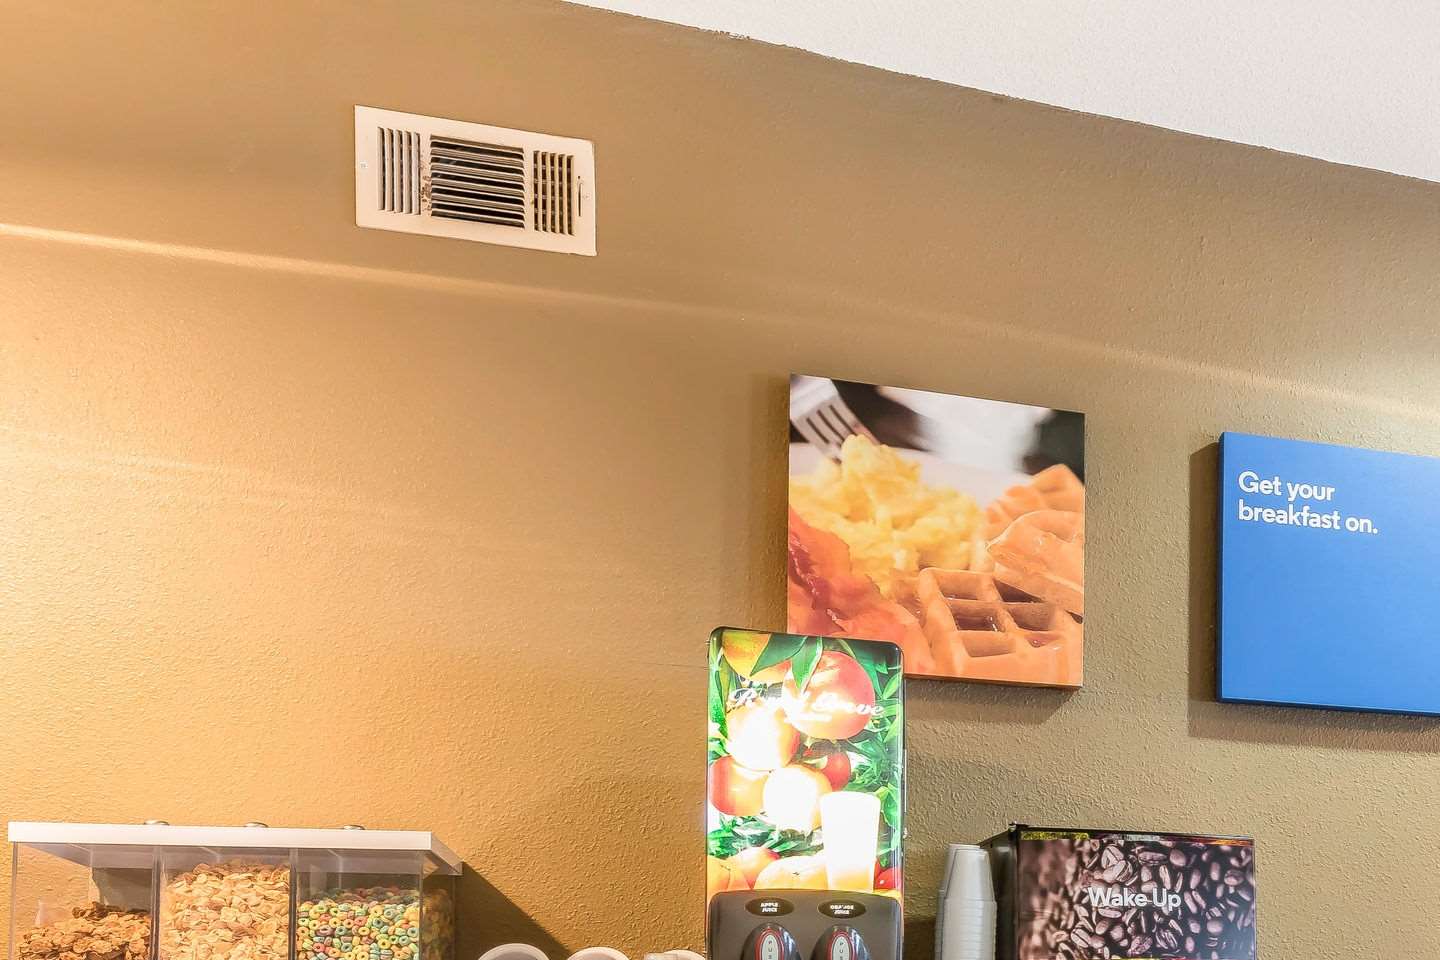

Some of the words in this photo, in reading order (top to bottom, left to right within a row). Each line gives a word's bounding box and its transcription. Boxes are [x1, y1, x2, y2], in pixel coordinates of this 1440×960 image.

[1238, 470, 1282, 496] Get
[1287, 482, 1336, 502] your
[1238, 498, 1341, 530] breakfast
[1345, 516, 1378, 534] on.
[1087, 887, 1148, 907] Wake
[1152, 887, 1182, 912] Up
